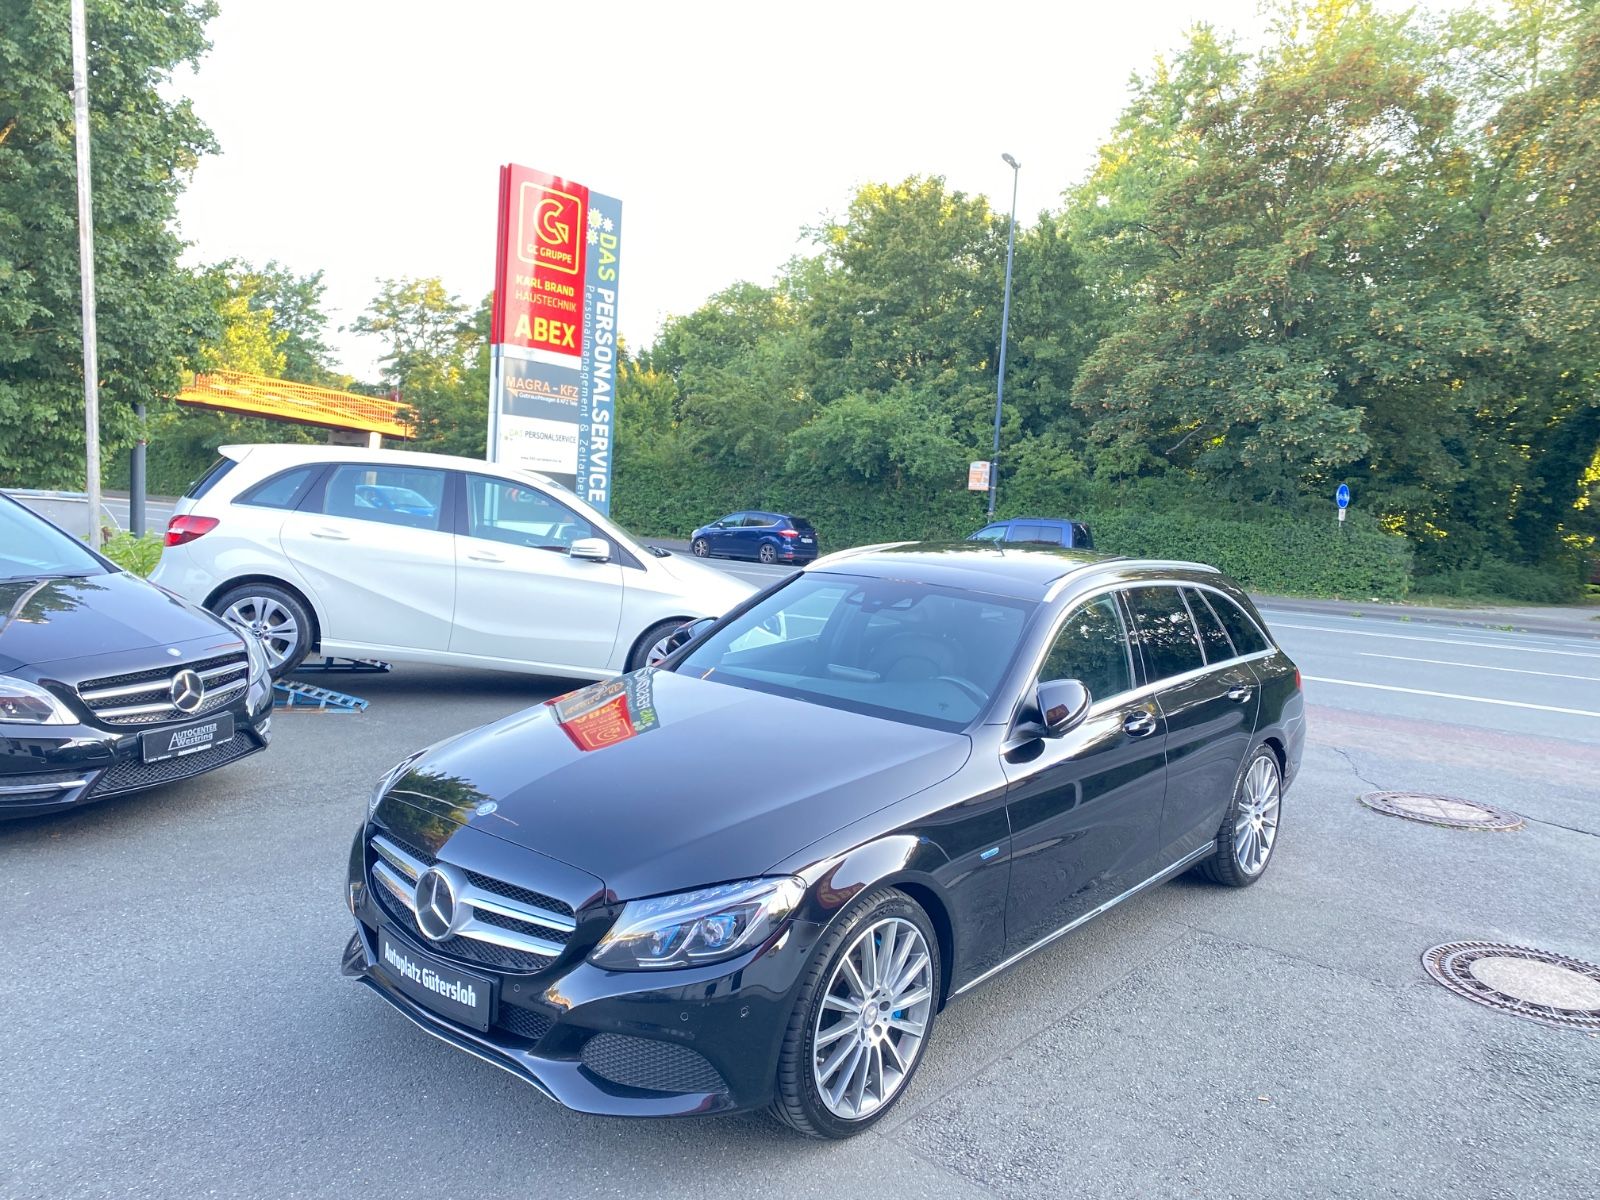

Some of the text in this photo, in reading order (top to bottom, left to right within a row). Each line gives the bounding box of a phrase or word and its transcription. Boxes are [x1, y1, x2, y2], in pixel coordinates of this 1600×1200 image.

[540, 246, 573, 264] GRUPPE
[515, 273, 575, 297] KARL BRAND
[515, 289, 577, 313] HAUSTECHNIK
[514, 313, 577, 348] ABEX
[579, 284, 596, 417] Personalmanagement
[588, 231, 618, 503] DAS PERSONALSERVICE
[505, 375, 551, 393] MAGRA
[560, 384, 579, 398] KFZ
[524, 430, 577, 444] PERSONALSERVICE
[580, 424, 589, 432] &
[176, 732, 214, 747] Westring
[385, 942, 476, 1007] Autoplatz Gütersloh
